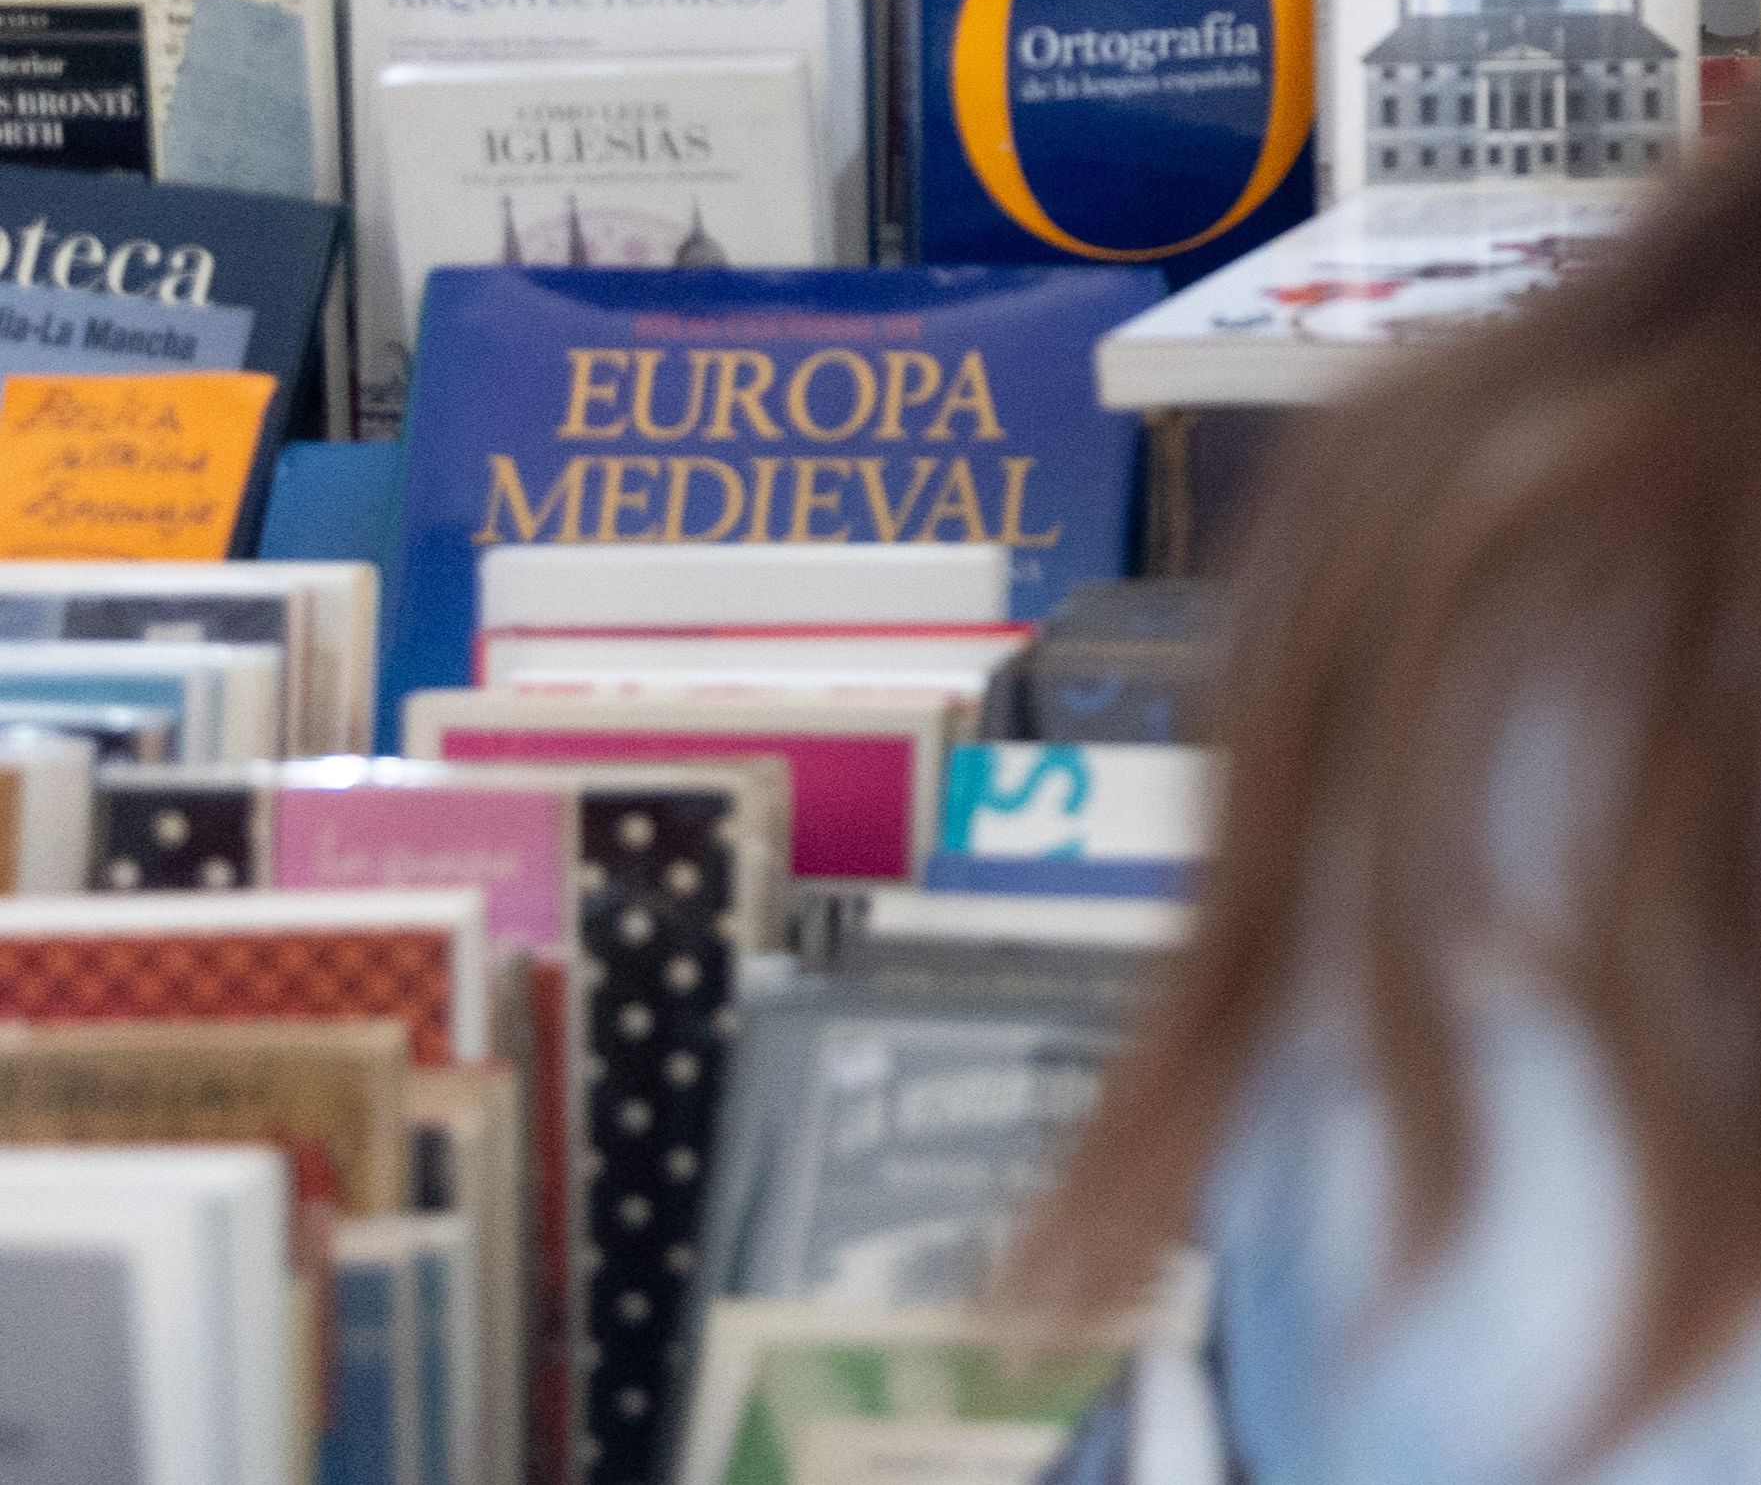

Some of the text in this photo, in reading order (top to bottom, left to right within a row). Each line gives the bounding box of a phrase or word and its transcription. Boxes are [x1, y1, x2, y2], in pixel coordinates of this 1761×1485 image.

[1020, 12, 1262, 72] Ortografía
[1022, 66, 1261, 110] de la lengua española
[483, 128, 711, 165] IGLESIAS
[559, 349, 1006, 442] EUROPA
[472, 455, 1063, 548] MEDIEVAL
